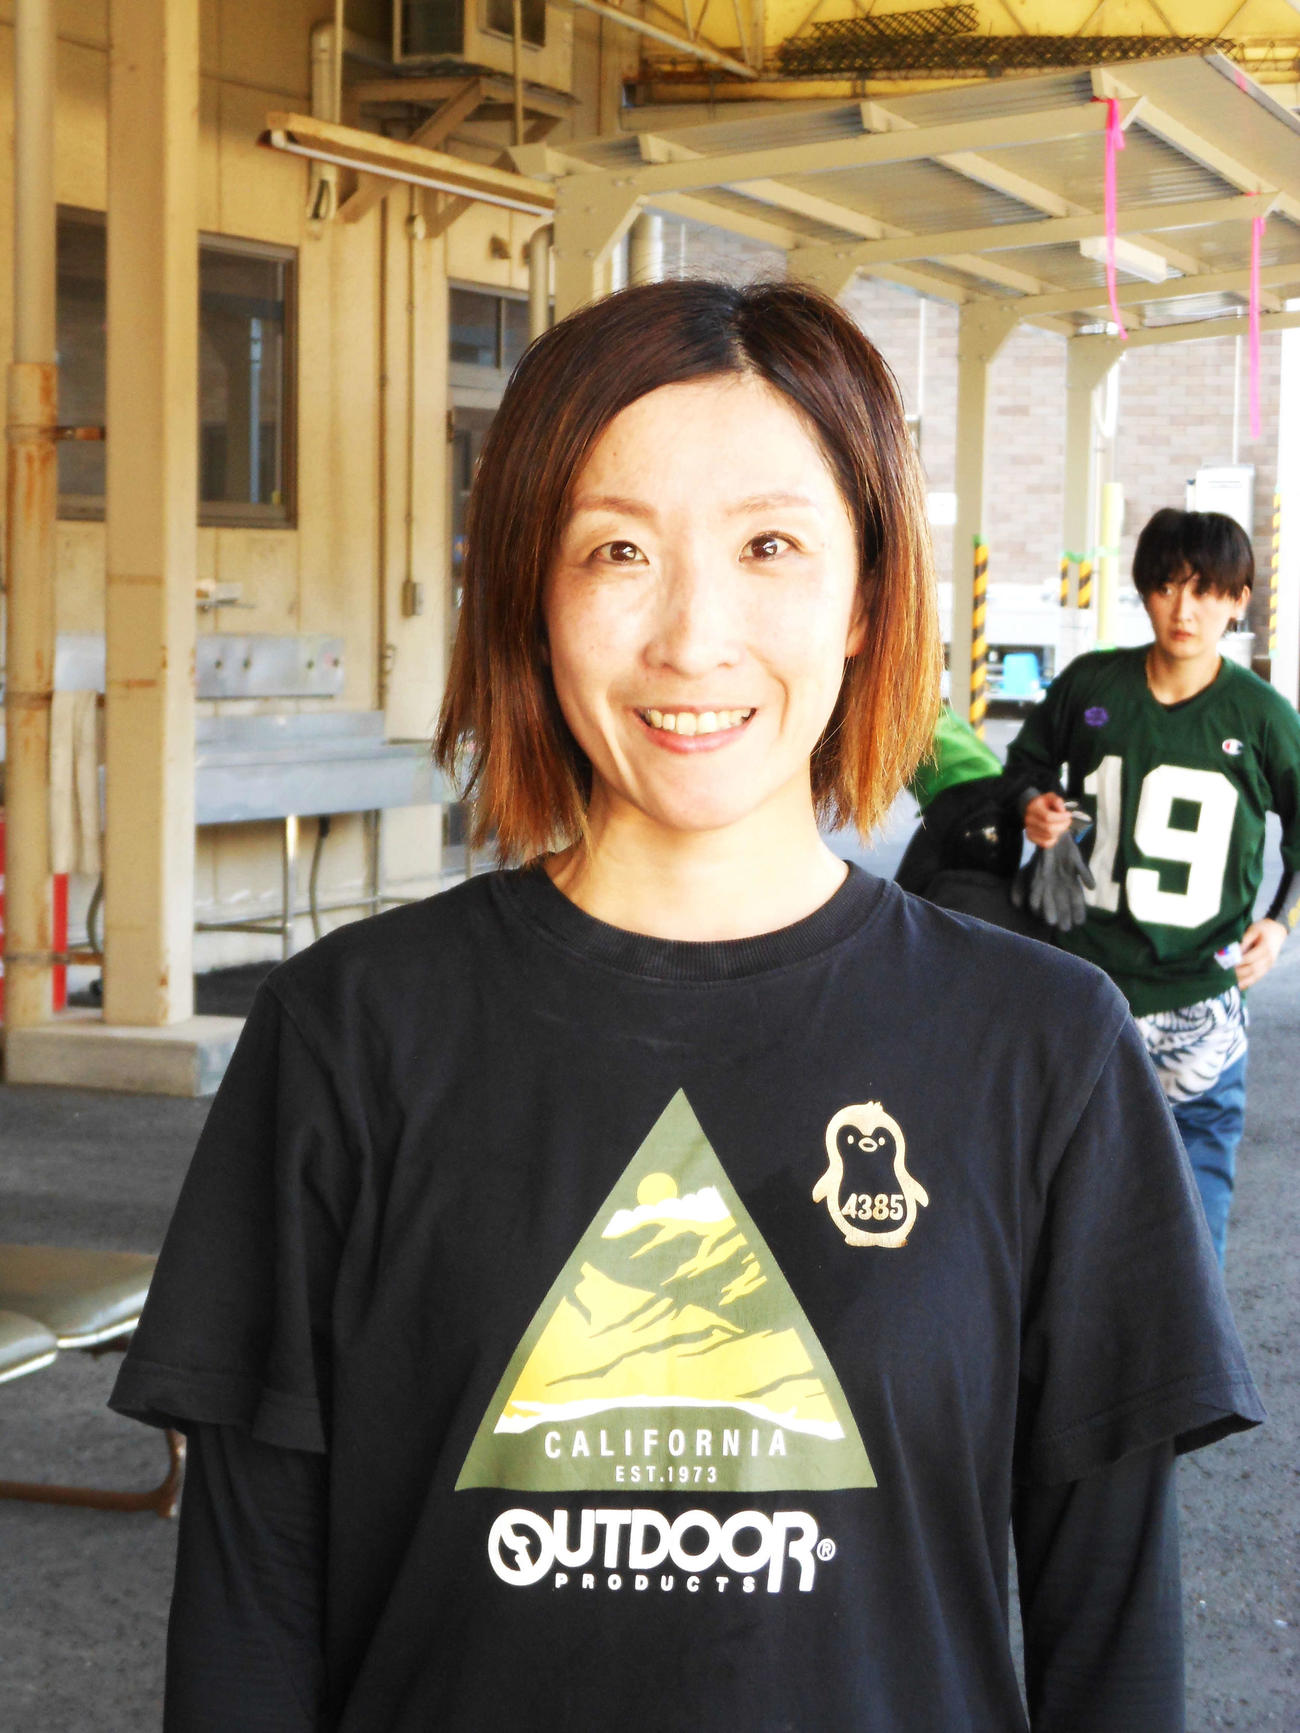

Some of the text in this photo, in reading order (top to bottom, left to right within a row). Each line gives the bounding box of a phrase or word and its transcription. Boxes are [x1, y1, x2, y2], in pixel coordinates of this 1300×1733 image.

[1082, 755, 1238, 929] 19
[841, 1193, 905, 1221] 4385
[545, 1429, 787, 1458] CALIFORNIA
[615, 1465, 718, 1484] EST.1973
[555, 1574, 755, 1593] PRODUCTS
